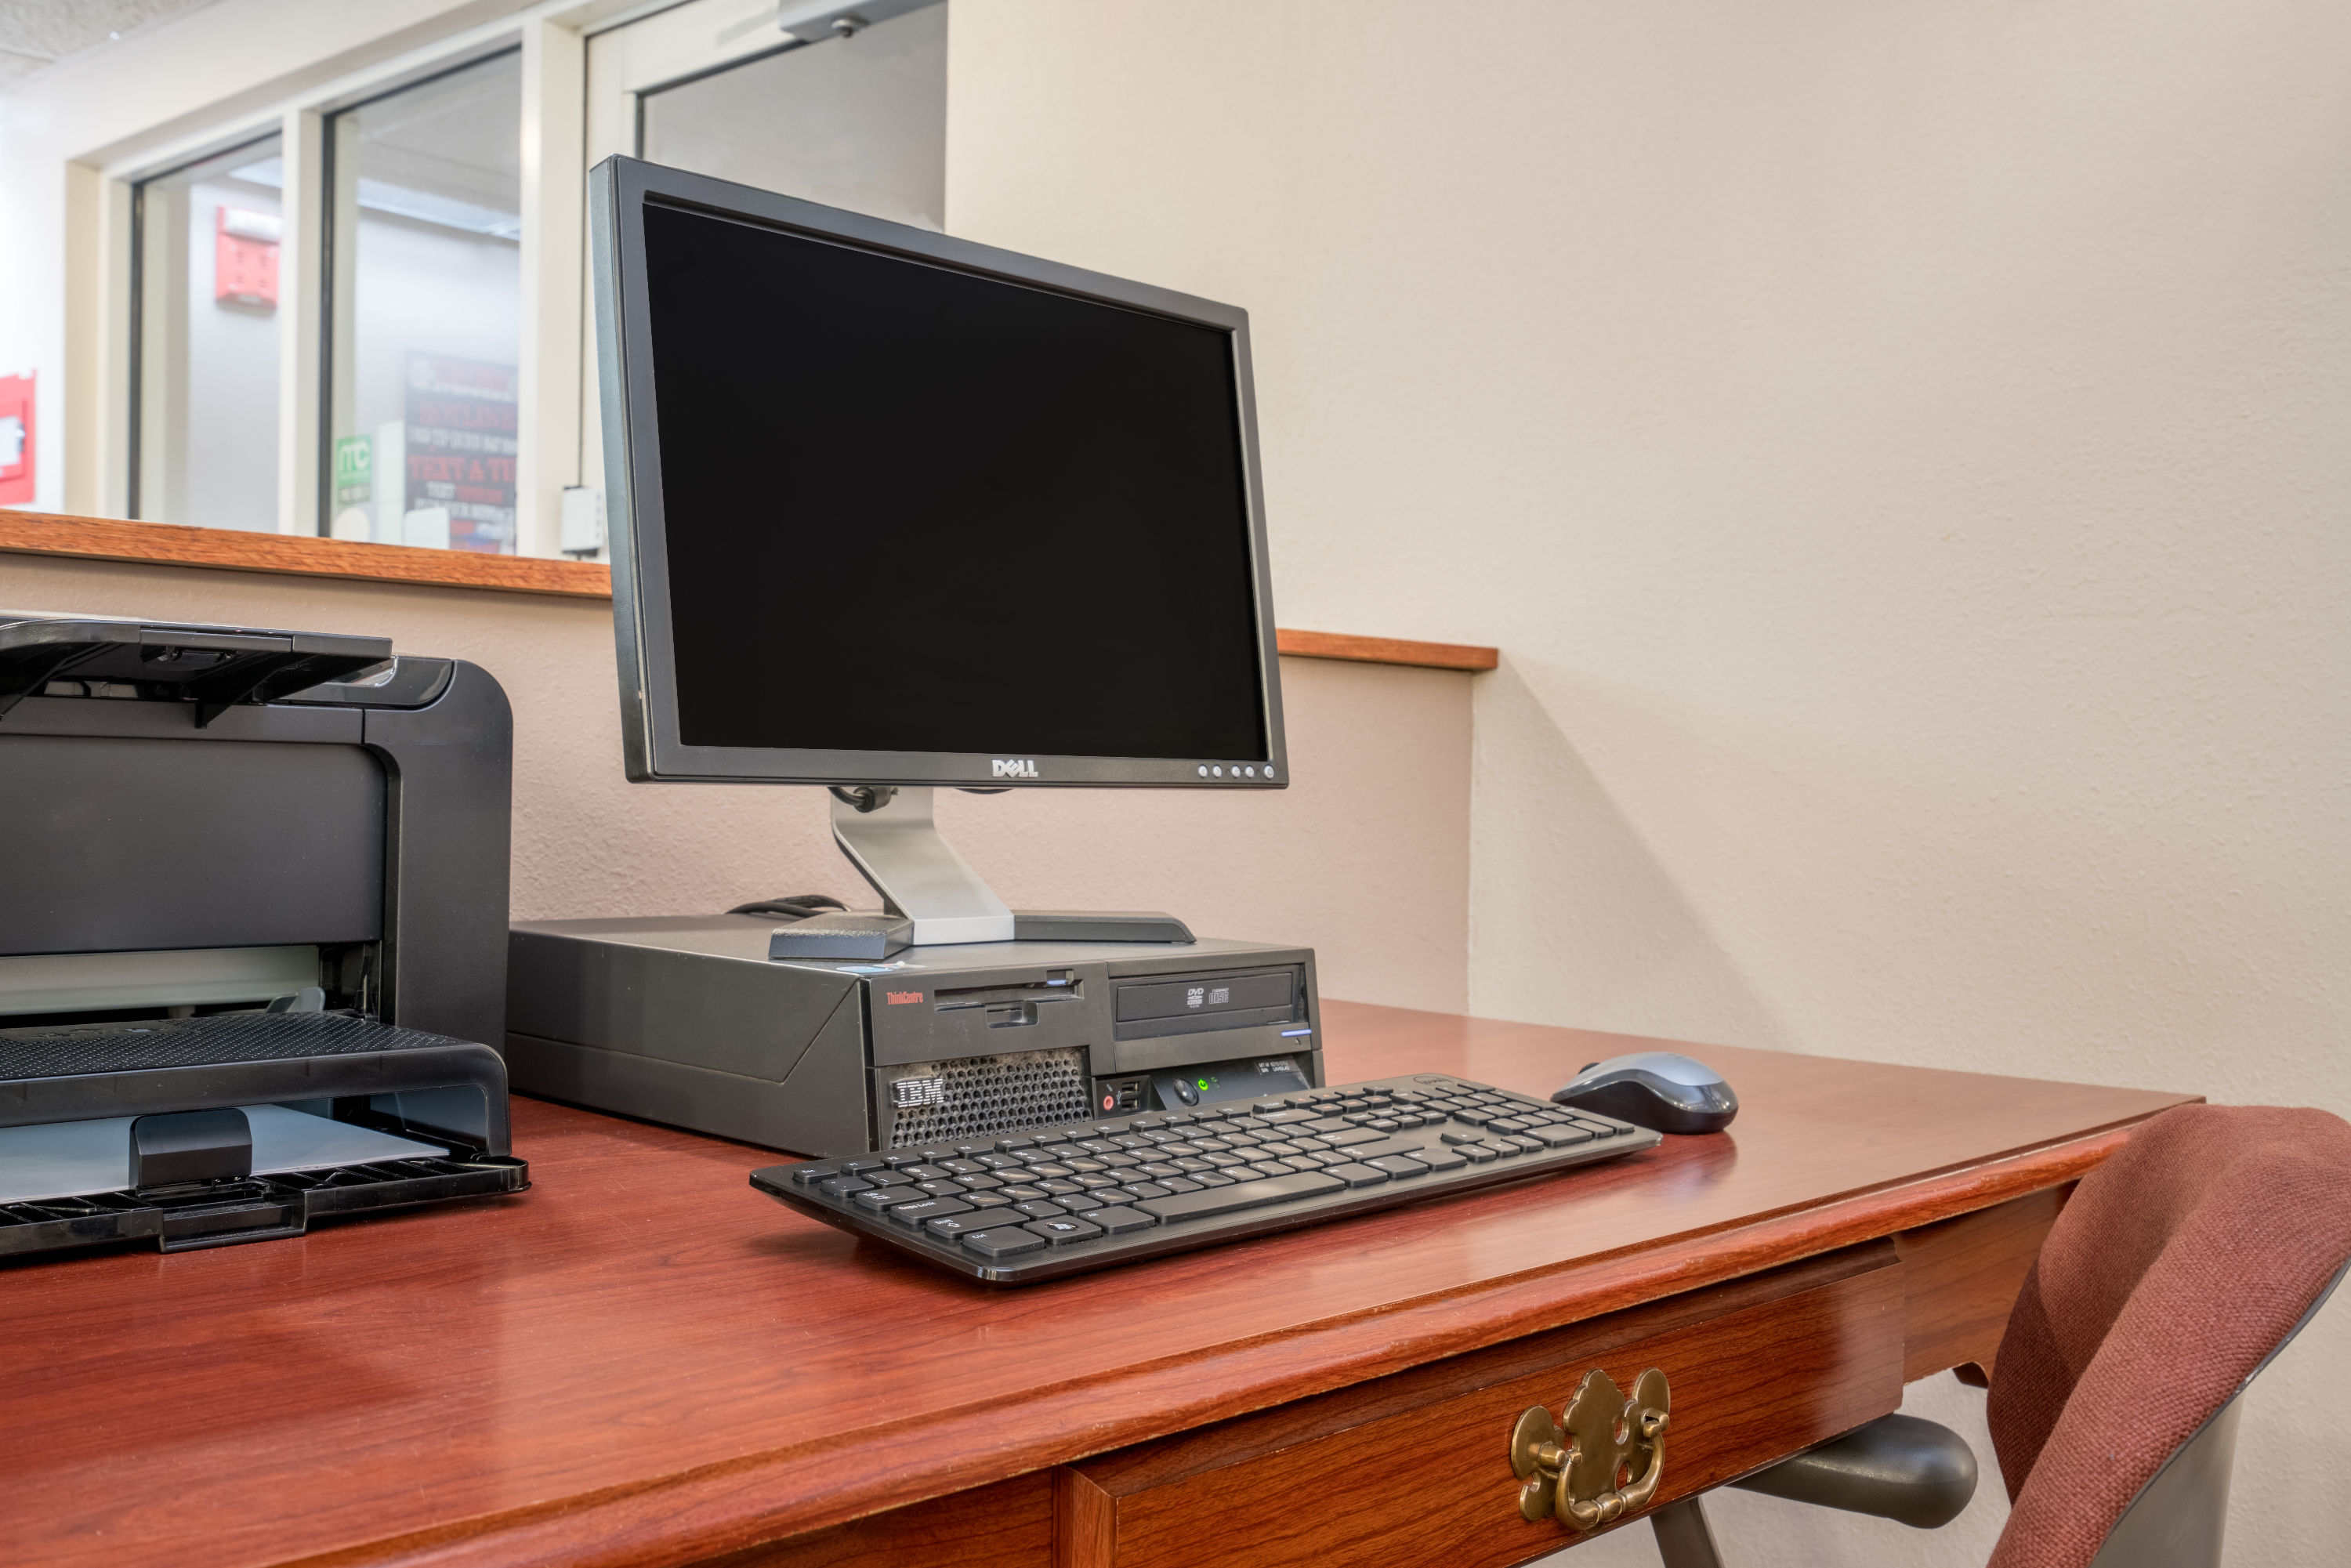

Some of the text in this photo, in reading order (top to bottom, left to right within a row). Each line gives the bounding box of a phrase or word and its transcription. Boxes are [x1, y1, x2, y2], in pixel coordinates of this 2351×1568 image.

[991, 759, 1039, 778] DELL
[886, 991, 924, 1005] ThinkCentre
[1187, 987, 1204, 996] DVD
[897, 1078, 944, 1108] IBM
